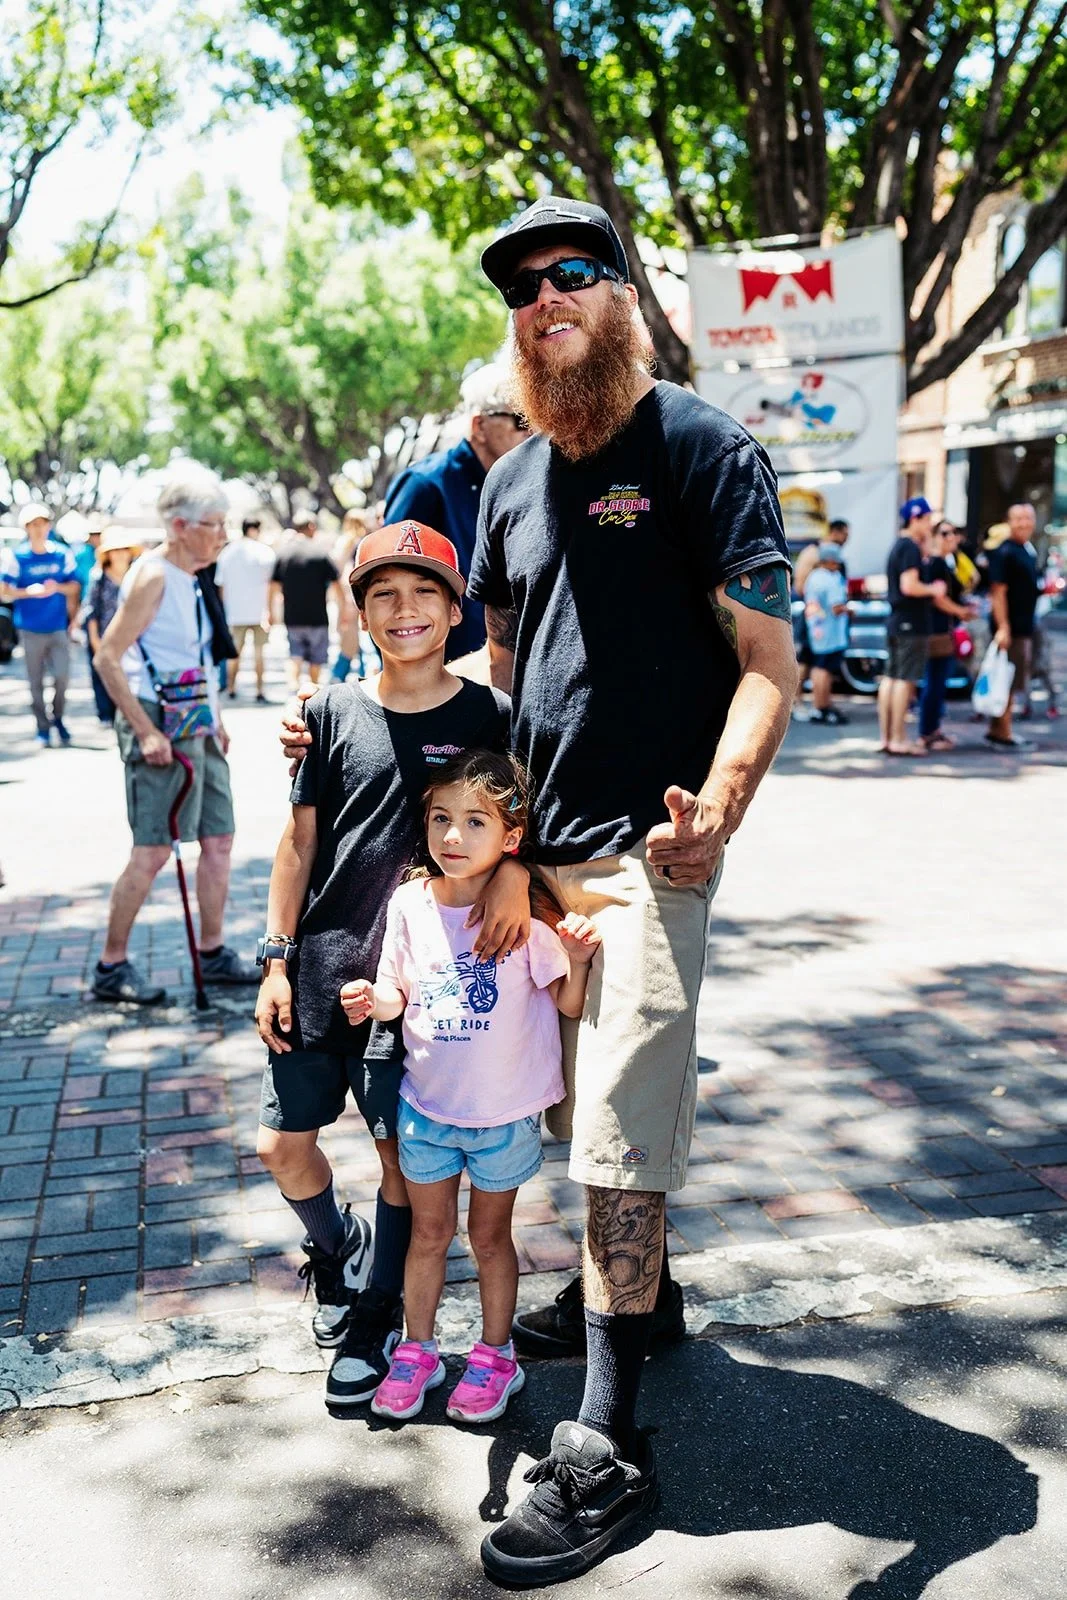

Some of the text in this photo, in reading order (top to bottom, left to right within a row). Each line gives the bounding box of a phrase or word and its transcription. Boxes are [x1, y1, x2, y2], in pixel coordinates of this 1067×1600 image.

[707, 326, 777, 348] TOYOTA
[609, 498, 650, 511] GEORGE
[394, 522, 424, 556] A
[460, 1019, 490, 1031] RIDE
